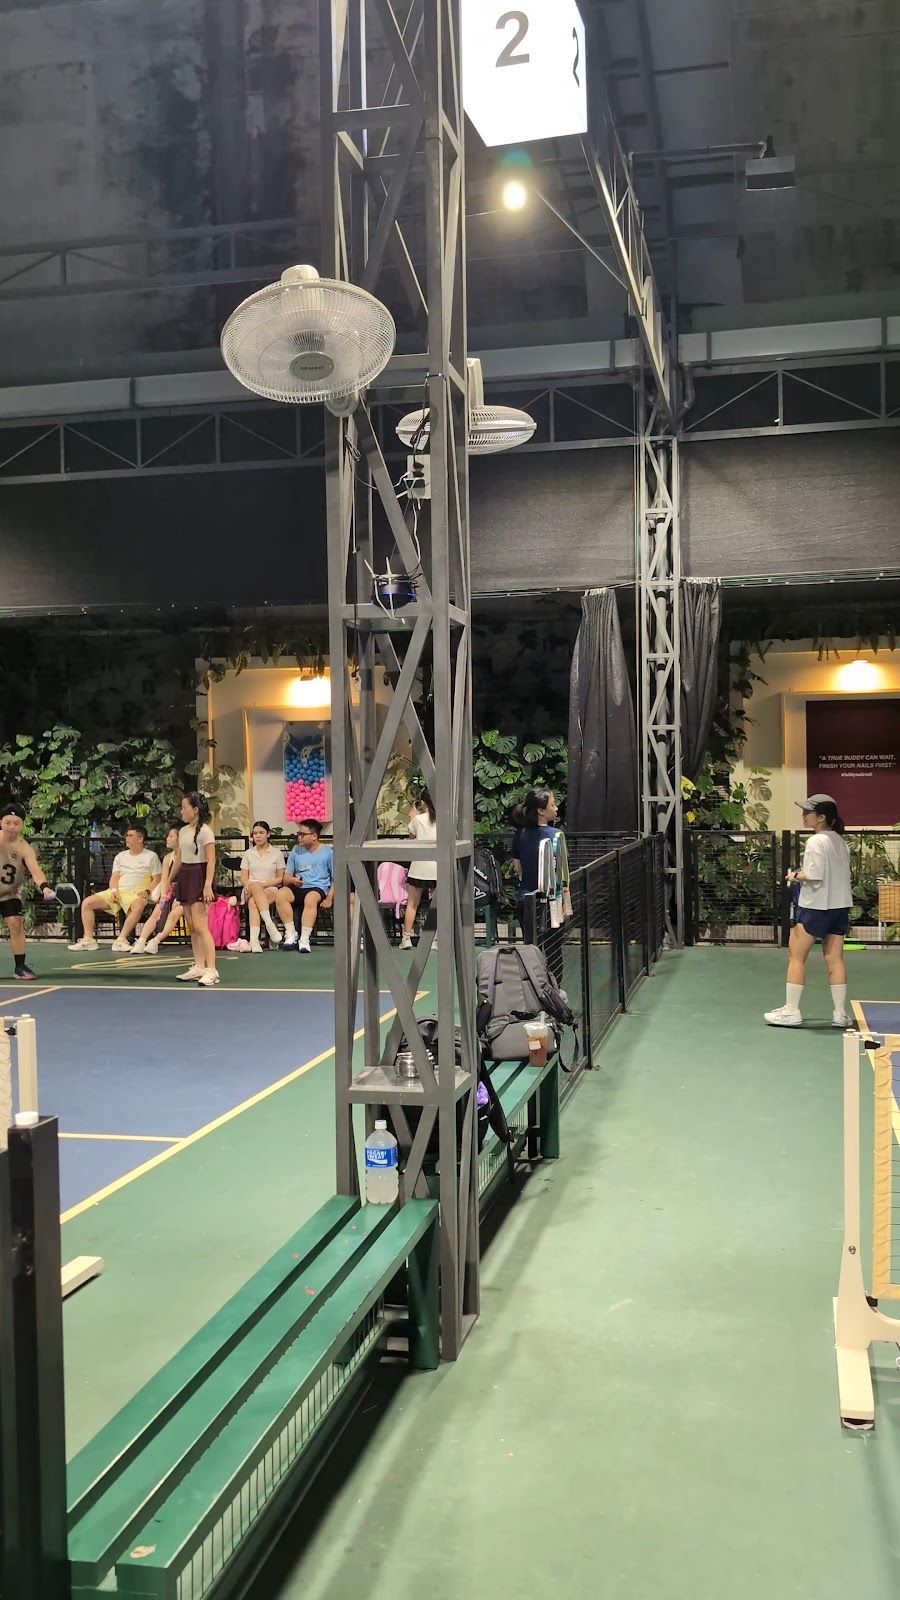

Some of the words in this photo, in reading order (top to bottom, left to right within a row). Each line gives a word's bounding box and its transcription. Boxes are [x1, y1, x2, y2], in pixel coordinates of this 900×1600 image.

[495, 10, 530, 68] 2
[572, 26, 580, 88] 2
[1, 863, 17, 885] 3
